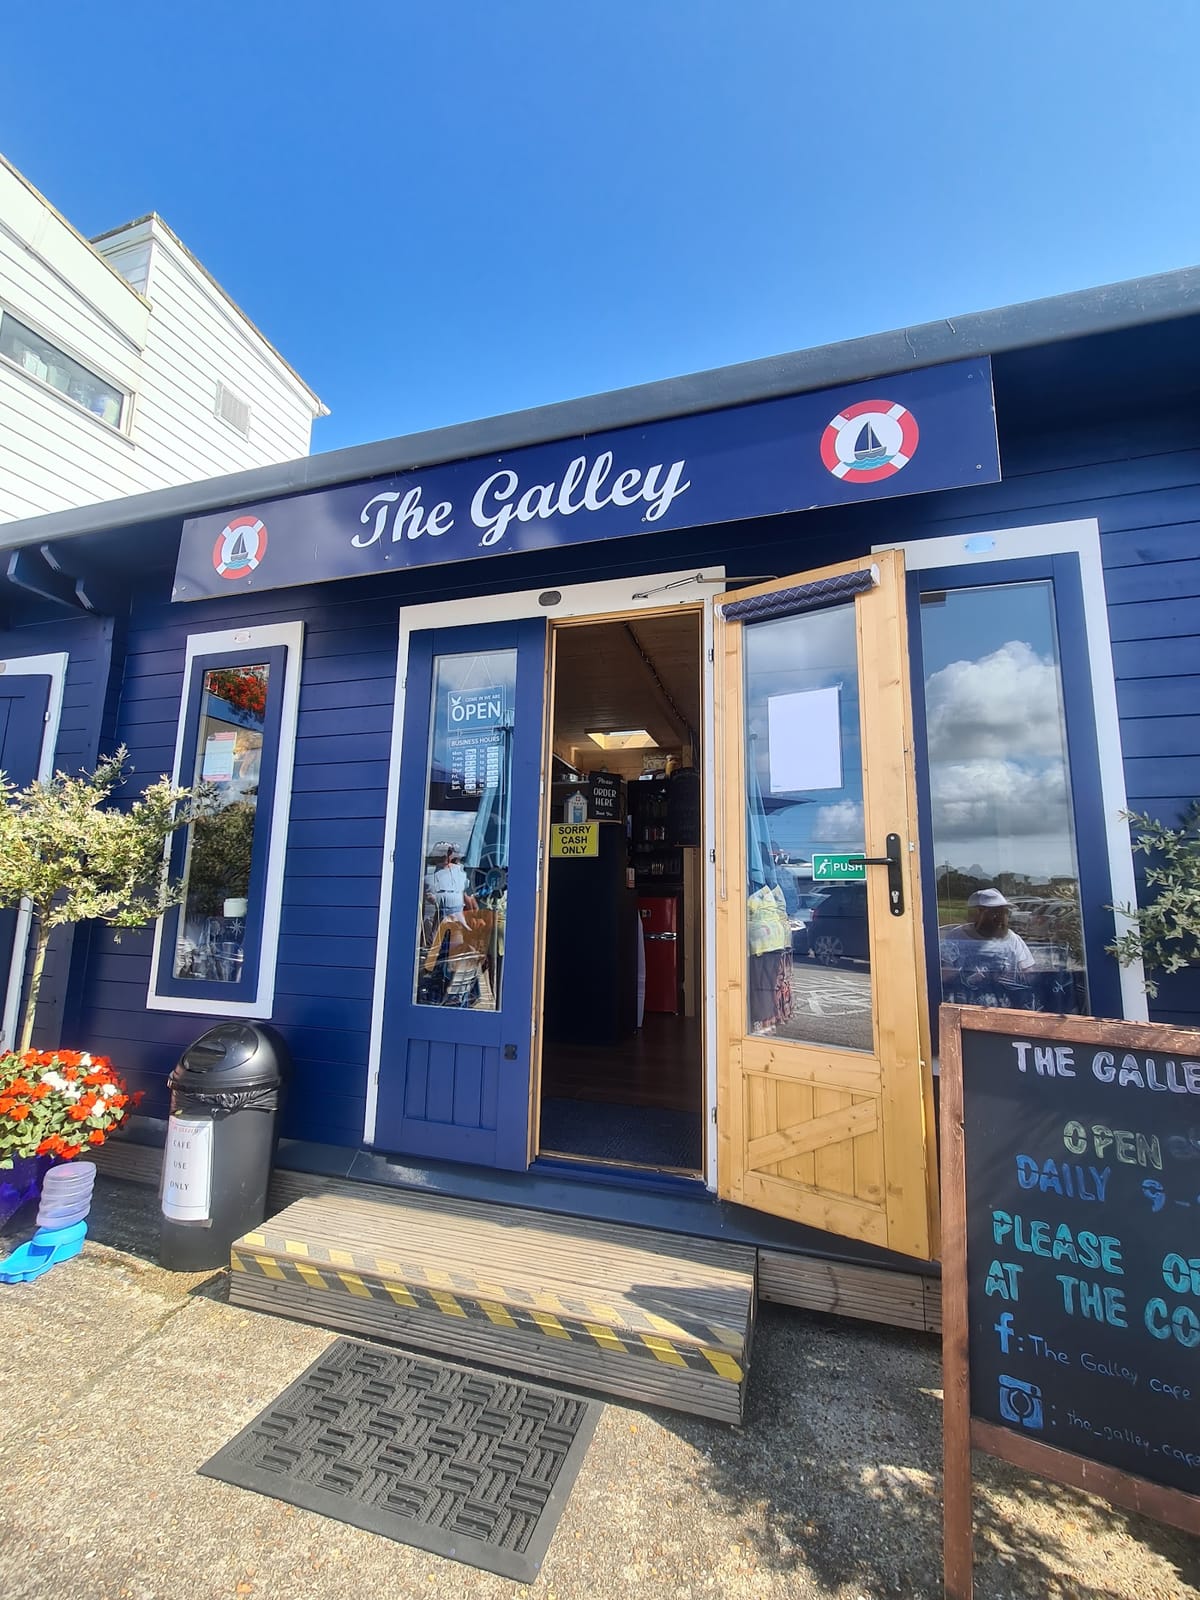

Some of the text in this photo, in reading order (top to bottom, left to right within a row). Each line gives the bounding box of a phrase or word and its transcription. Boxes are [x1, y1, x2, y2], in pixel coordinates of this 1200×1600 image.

[351, 451, 691, 548] The Galley
[452, 701, 500, 722] OPEN
[451, 735, 500, 747] BUSINESS HOURS
[593, 787, 617, 798] ORDER
[595, 797, 614, 808] HERE
[558, 825, 591, 835] SORRY
[561, 836, 588, 845] CASH
[561, 845, 587, 855] ONLY
[833, 862, 863, 871] PUSH
[1012, 1041, 1076, 1078] THE
[1063, 1120, 1163, 1170] OPEN
[173, 1160, 188, 1170] USE
[1015, 1154, 1111, 1201] DAILY
[169, 1180, 190, 1191] ONLY
[992, 1210, 1124, 1275] PLEASE
[985, 1259, 1024, 1301] AT
[1056, 1275, 1128, 1328] THE
[1028, 1334, 1070, 1365] The
[1080, 1353, 1138, 1386] Galley
